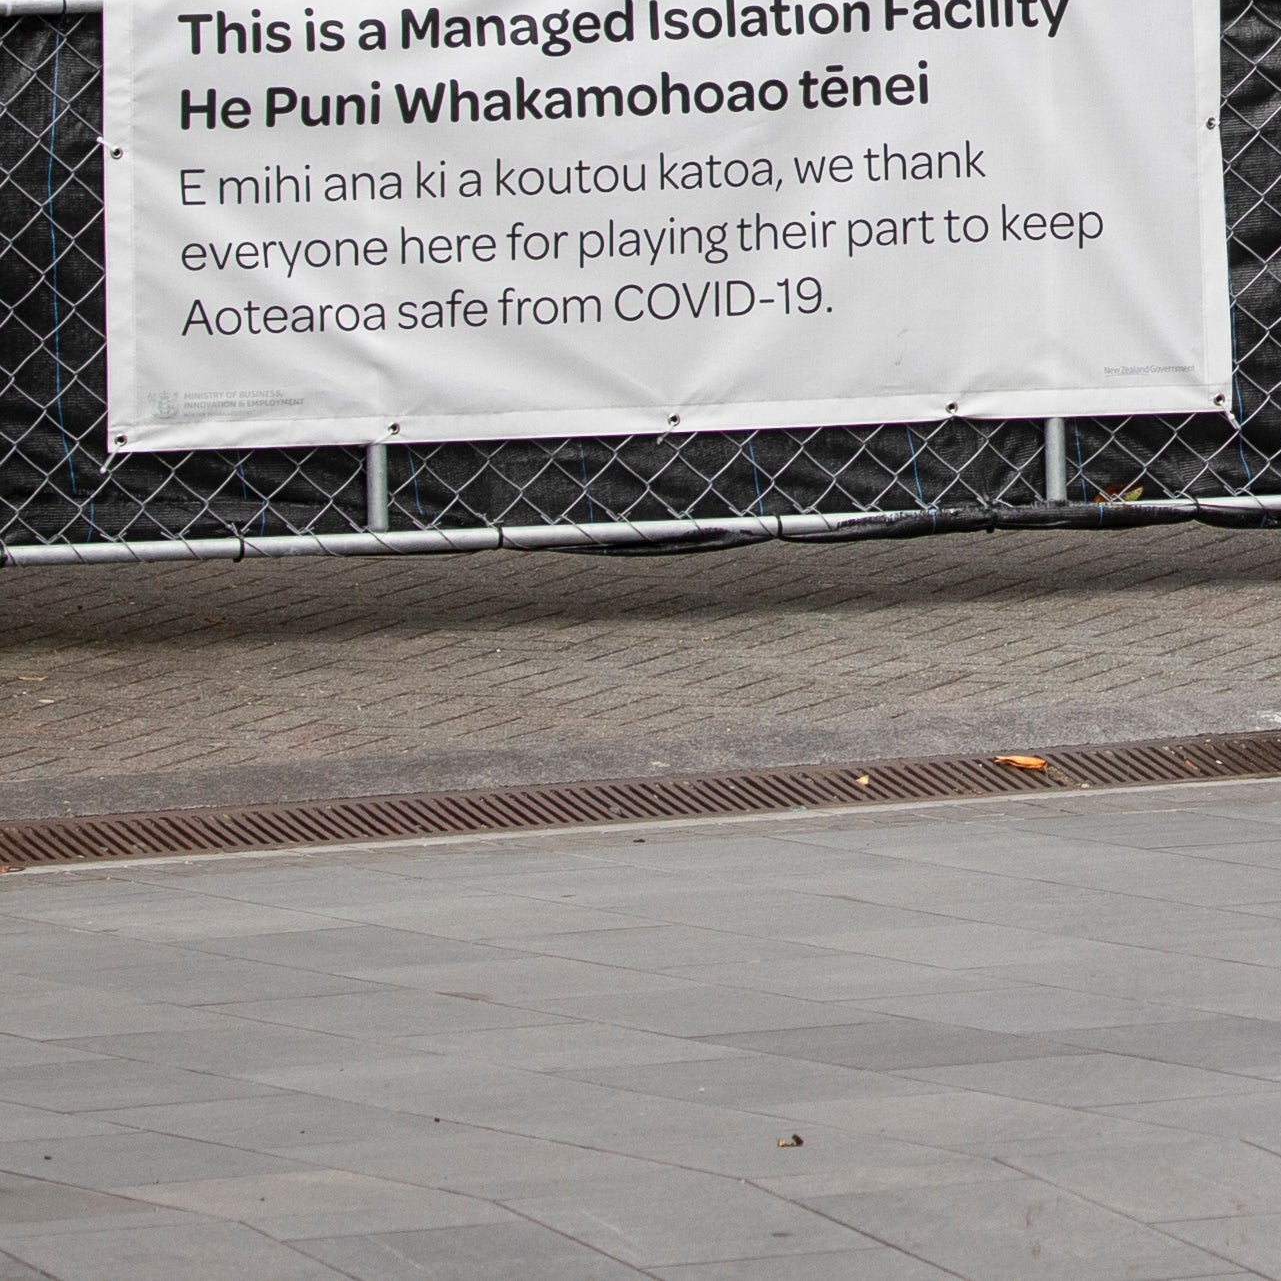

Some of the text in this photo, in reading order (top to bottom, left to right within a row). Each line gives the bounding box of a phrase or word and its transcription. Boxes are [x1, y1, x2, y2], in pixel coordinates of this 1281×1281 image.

[178, 9, 291, 55] This
[305, 8, 345, 52] is
[359, 19, 386, 50] a
[181, 60, 928, 130] He Puni Whakamohoao tēnei
[181, 140, 985, 205] E mihi ana ki a koutou katoa, we thank
[182, 204, 1103, 278] everyone here for playing their part to keep
[182, 277, 832, 336] Aotearoa safe from COVID-19.
